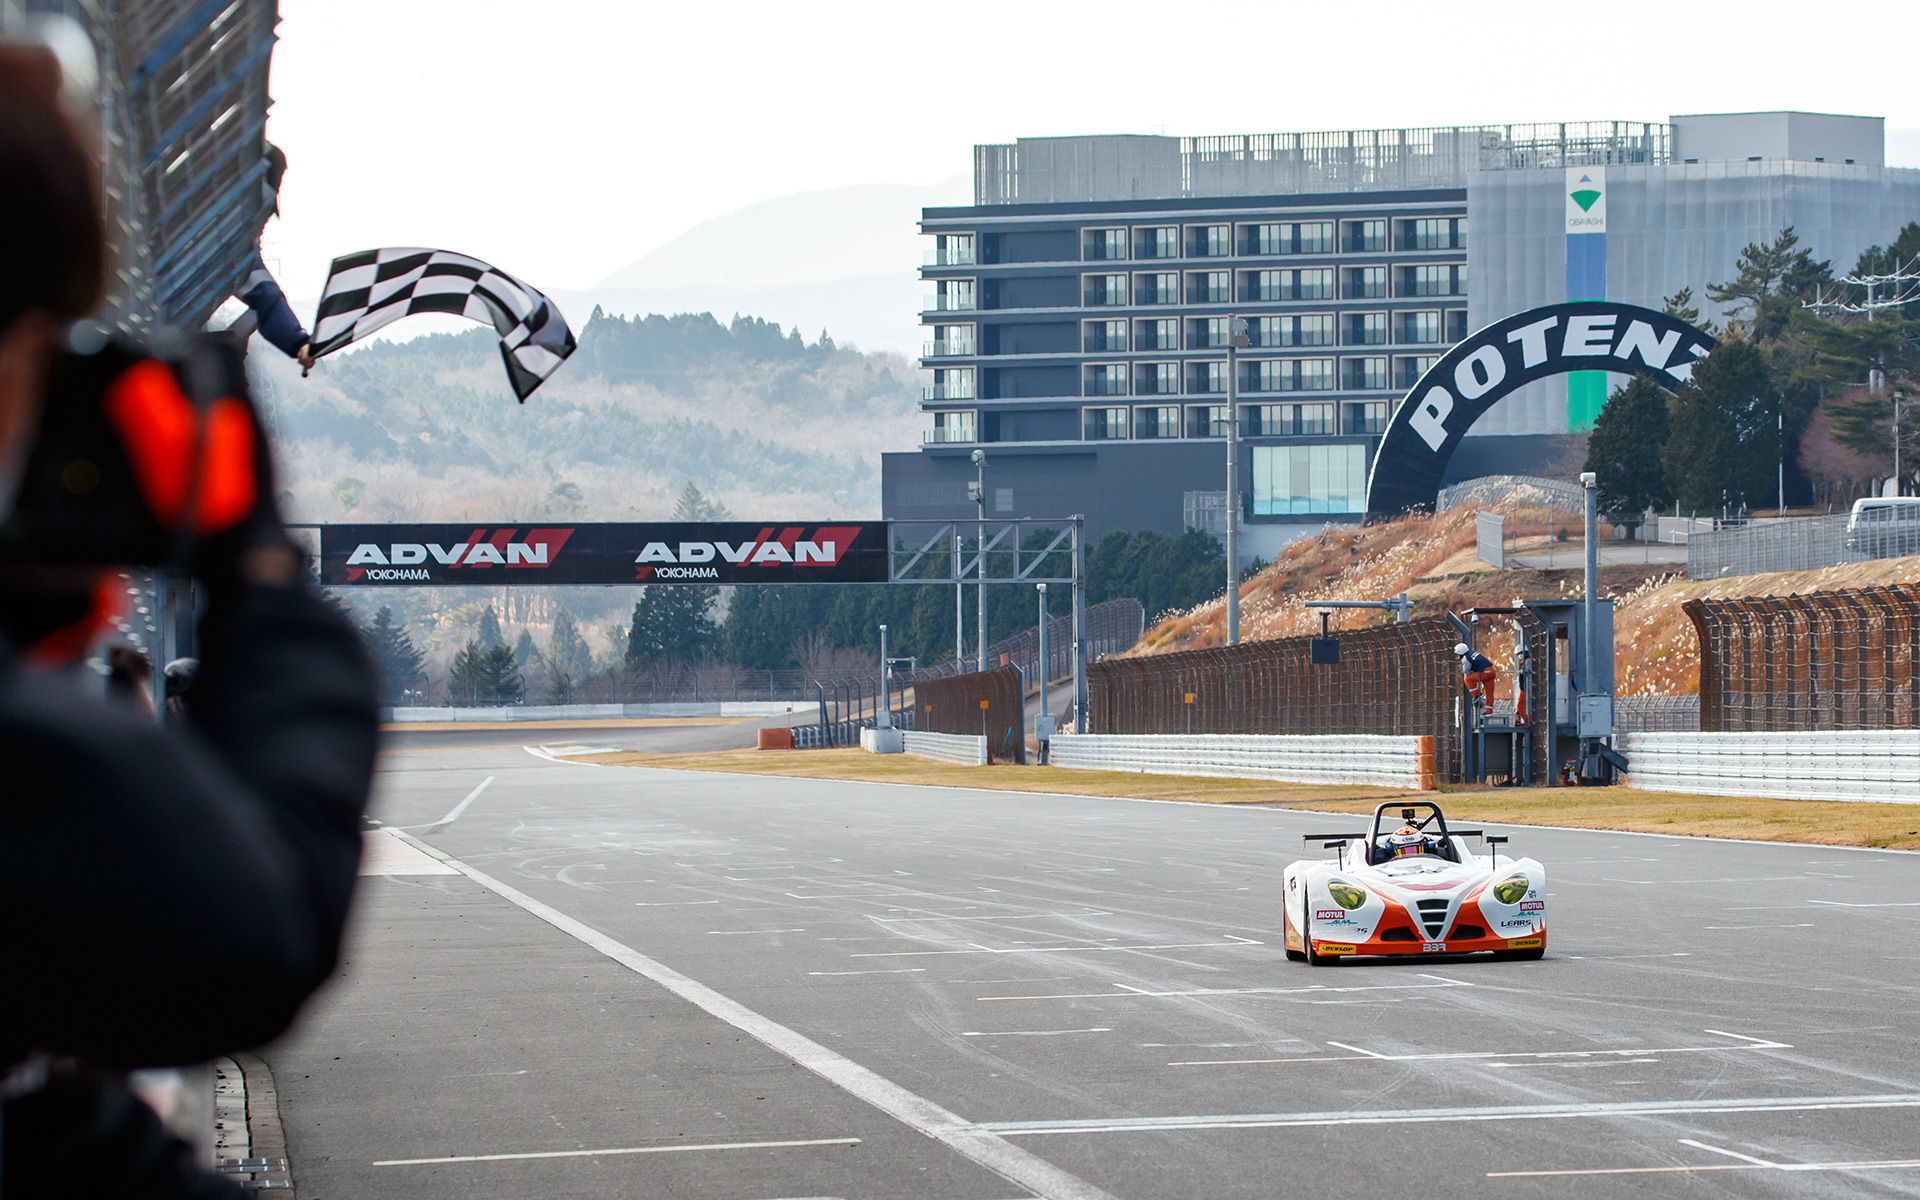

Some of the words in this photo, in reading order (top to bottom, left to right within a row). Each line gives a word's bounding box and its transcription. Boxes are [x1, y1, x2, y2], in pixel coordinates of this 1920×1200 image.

[1568, 217, 1604, 226] OBAYASHI
[345, 543, 548, 565] ADVAN
[634, 541, 836, 563] ADVAN
[365, 569, 430, 580] YOKOHAMA
[654, 567, 718, 578] YOKOHAMA
[1521, 902, 1544, 910] MOTUL
[1317, 911, 1344, 919] MOTUL
